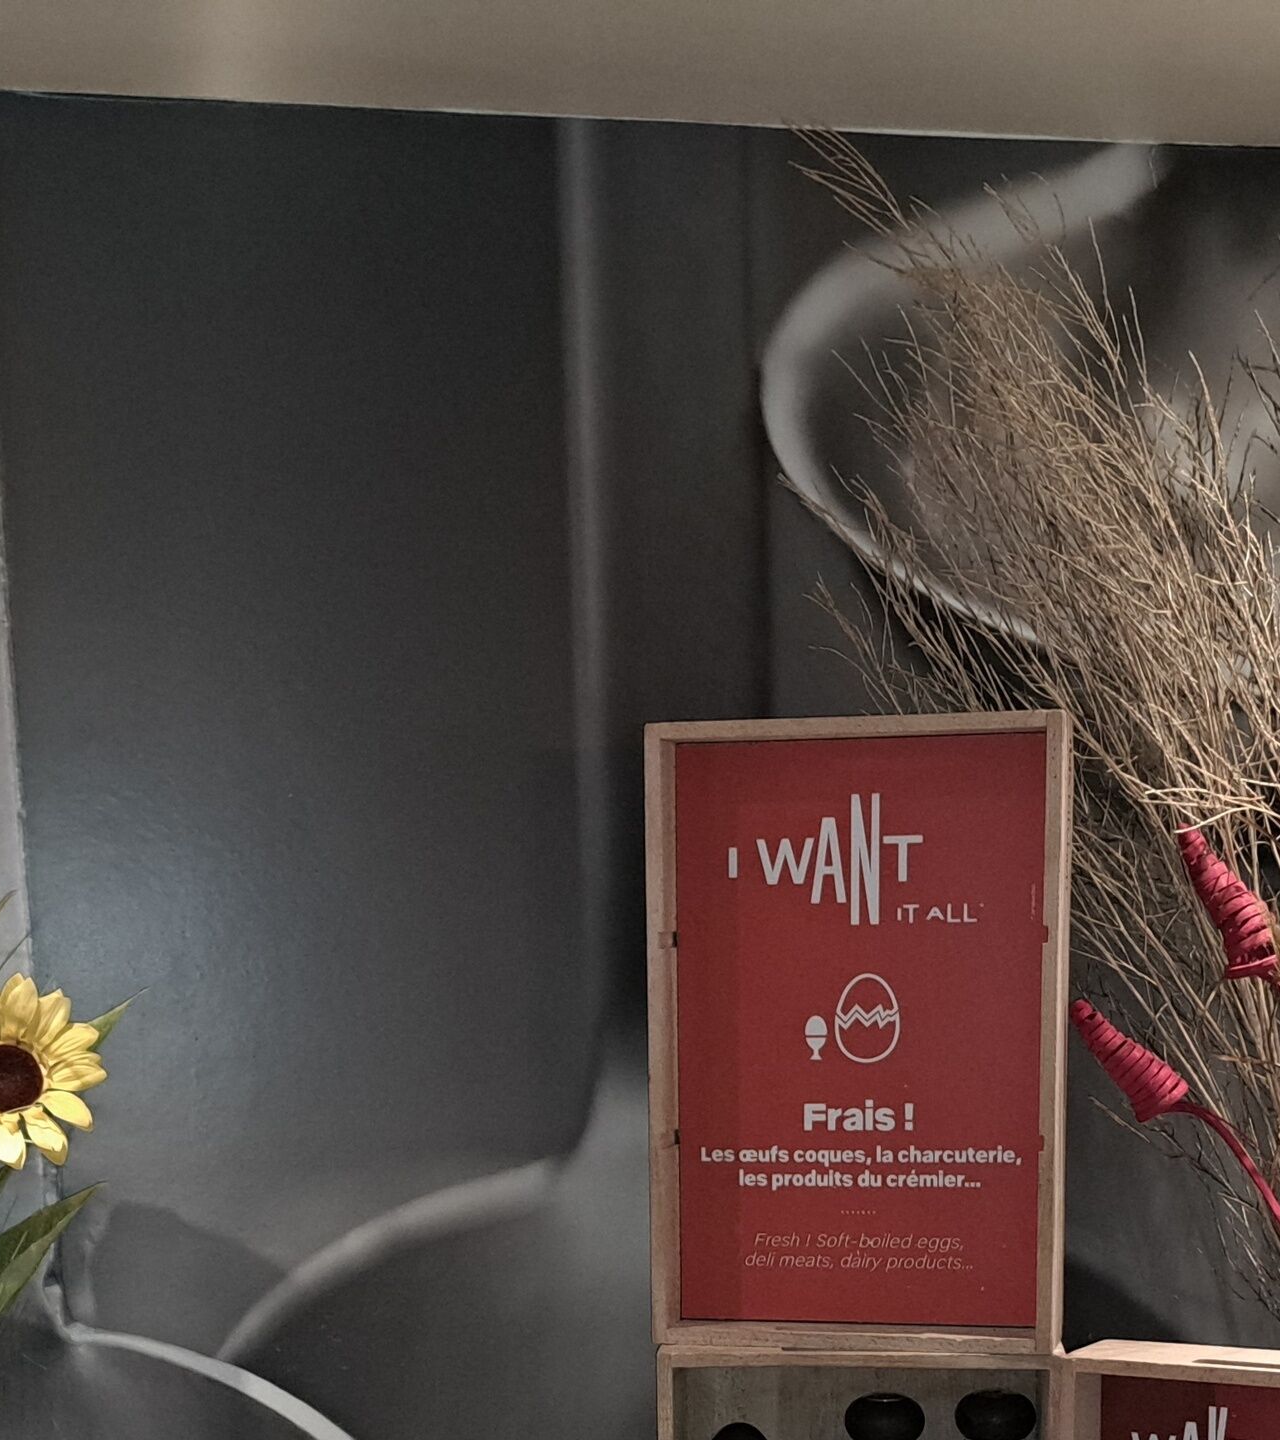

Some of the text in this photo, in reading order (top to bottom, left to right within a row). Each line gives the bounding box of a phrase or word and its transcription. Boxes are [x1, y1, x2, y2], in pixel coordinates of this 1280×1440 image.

[728, 793, 923, 925] I WANT
[897, 904, 920, 923] IT
[803, 1099, 914, 1131] Frais !
[700, 1145, 1022, 1167] Les œufs coques, la charcuterie,
[739, 1169, 982, 1191] les produits du crémier...
[754, 1232, 800, 1248] Fresh
[816, 1233, 912, 1249] Soft-boiled
[917, 1237, 965, 1253] eggs,
[745, 1252, 773, 1267] deli
[779, 1254, 835, 1269] meats,
[840, 1252, 882, 1272] dairy
